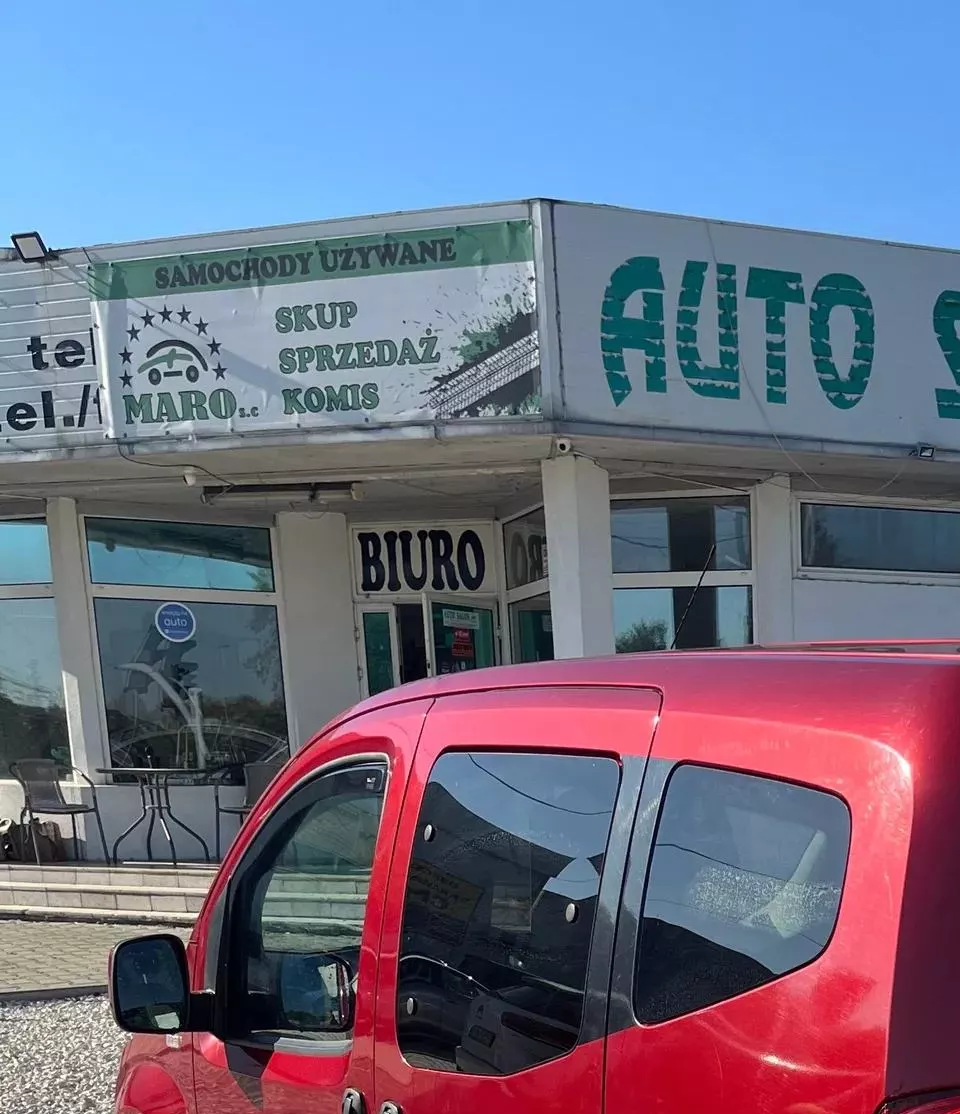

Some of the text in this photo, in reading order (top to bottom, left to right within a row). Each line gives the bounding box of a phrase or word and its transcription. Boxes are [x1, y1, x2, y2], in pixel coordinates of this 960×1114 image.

[155, 238, 457, 289] SAMOCHODY UŻYWANE
[275, 301, 357, 333] SKUP
[600, 256, 874, 409] AUTO
[279, 328, 441, 374] SPRZEDAŻ
[122, 388, 237, 425] MARO
[281, 383, 380, 415] KOMIS
[357, 530, 486, 591] BIURO
[163, 617, 188, 627] auto
